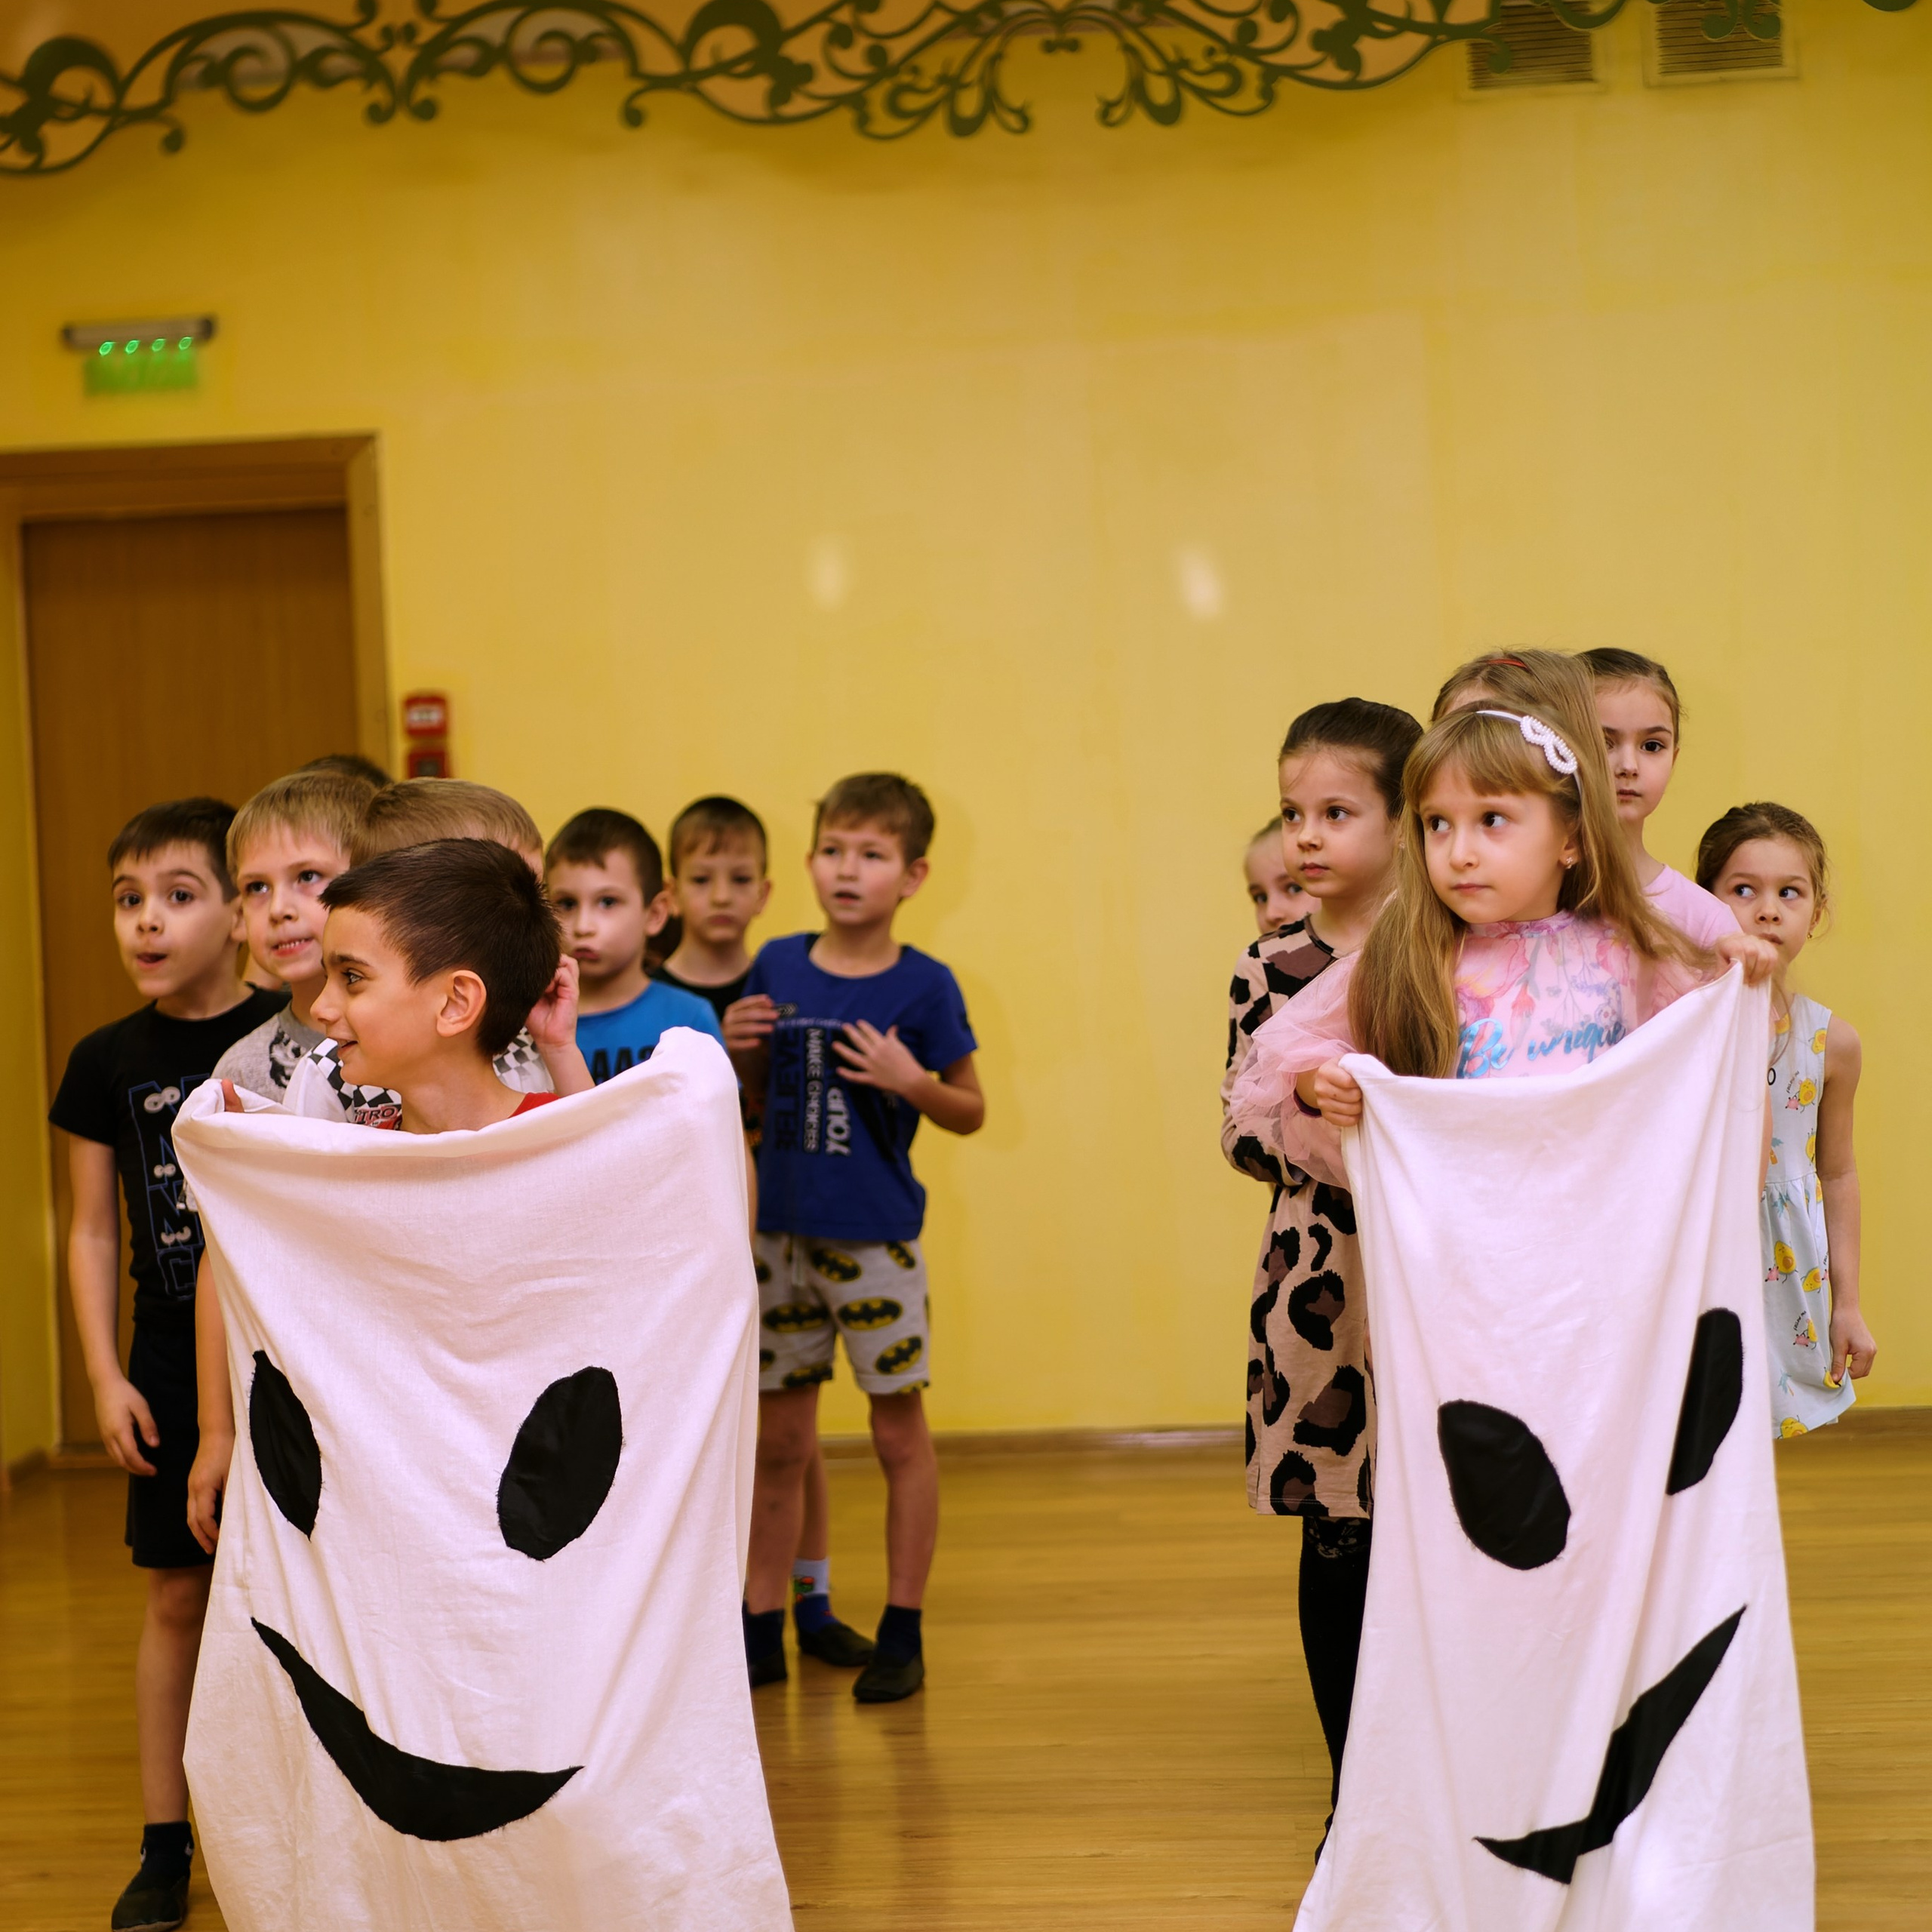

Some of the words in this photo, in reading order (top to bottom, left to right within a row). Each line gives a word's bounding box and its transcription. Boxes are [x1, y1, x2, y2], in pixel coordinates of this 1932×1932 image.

[805, 1028, 824, 1078] MAKE
[1457, 1018, 1514, 1078] Be
[1527, 1021, 1626, 1063] unique
[826, 1087, 851, 1155] YOUR
